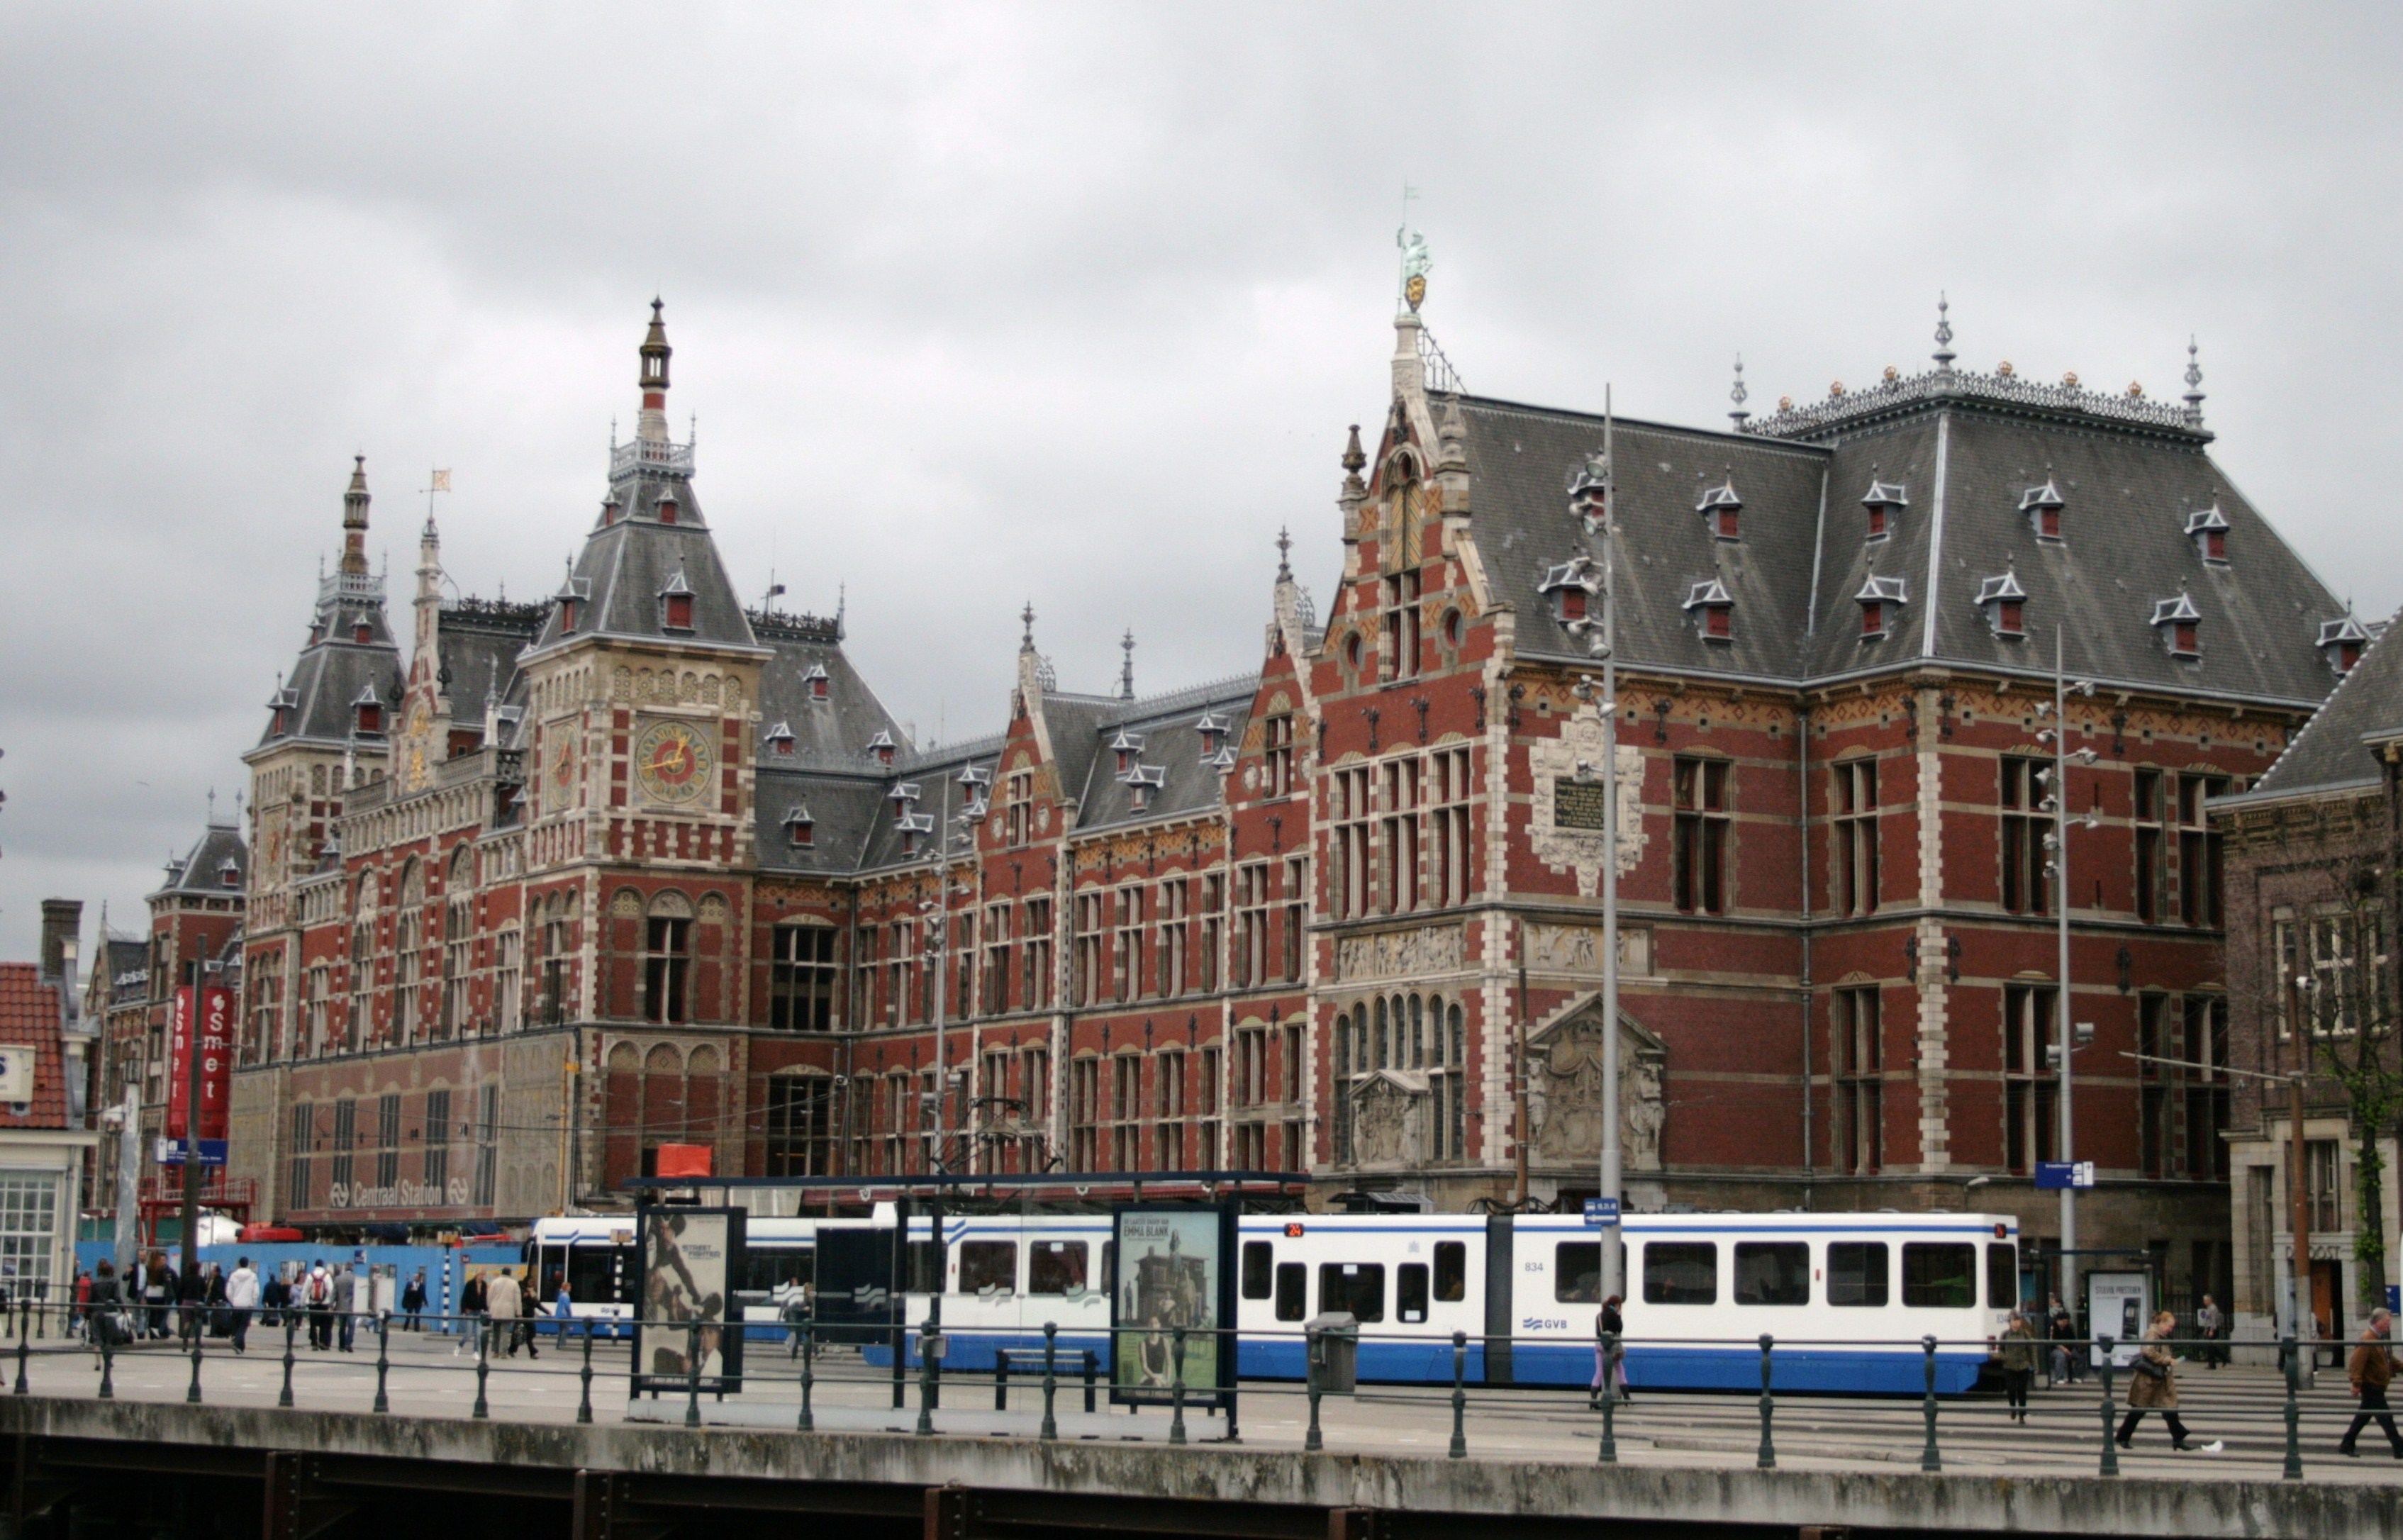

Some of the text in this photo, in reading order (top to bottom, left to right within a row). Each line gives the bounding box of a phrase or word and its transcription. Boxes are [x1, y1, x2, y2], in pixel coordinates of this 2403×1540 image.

[355, 1178, 442, 1207] Centraal Station
[1124, 1226, 1169, 1237] EMMA BLANK
[1524, 1262, 1544, 1271] 834
[1544, 1319, 1567, 1329] GVB
